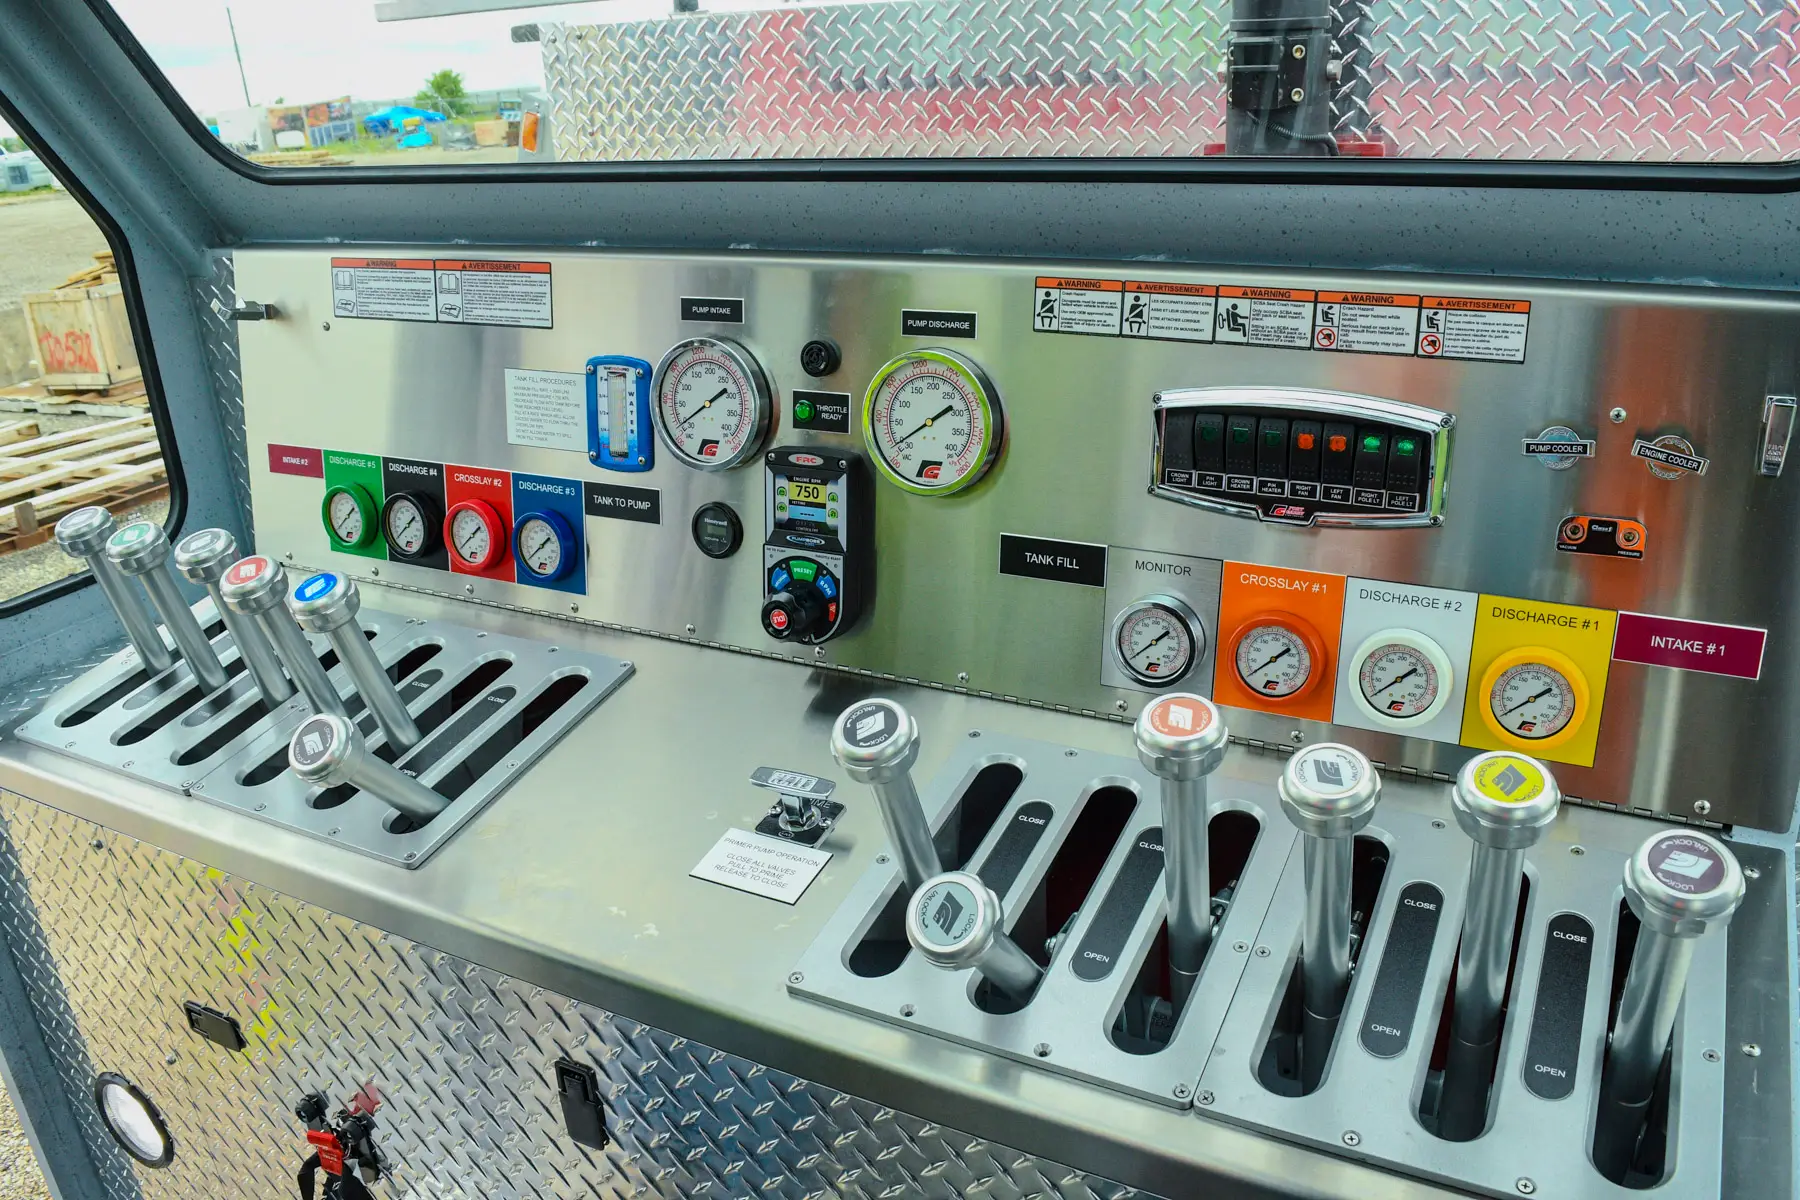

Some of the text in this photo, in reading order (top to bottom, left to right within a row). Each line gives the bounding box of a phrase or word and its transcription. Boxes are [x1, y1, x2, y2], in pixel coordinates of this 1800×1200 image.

[469, 262, 520, 270] AVERTISSEMENT
[1144, 284, 1204, 293] AVERTISSEMENT
[1250, 289, 1290, 298] WARNING
[1351, 295, 1394, 304] WARNING
[1446, 300, 1516, 309] AVERTISSEMENT
[692, 306, 730, 315] PUMP INTAKE
[929, 320, 970, 330] DISCHARGE
[912, 360, 927, 369] 1200
[692, 371, 702, 379] 150
[540, 378, 576, 386] PROCEDURES
[886, 376, 896, 388] 800
[817, 405, 847, 414] THROTTLE
[822, 412, 842, 421] READY
[952, 428, 965, 436] 350
[1530, 445, 1583, 453] PUMP COOLER
[282, 457, 300, 465] INTAKE
[329, 456, 366, 468] DISCHARGE
[796, 456, 816, 464] FRC
[1640, 447, 1698, 469] ENGINE COOLER
[389, 462, 437, 476] DISCHARGE #4
[454, 473, 502, 487] CROSSLAY #2
[519, 481, 575, 496] DISCHARGE #3
[796, 485, 819, 499] 750
[593, 495, 650, 510] TANK TO PUMP
[1025, 552, 1079, 569] TANK FILL
[1135, 560, 1192, 577] MONITOR
[820, 580, 831, 595] RPM
[1240, 573, 1327, 593] CROSSLAY #1
[1359, 588, 1462, 612] DISCHARGE #2
[1492, 606, 1599, 631] DISCHARGE #1
[1650, 634, 1726, 656] INTAKE #1
[851, 706, 875, 719] UNLOCK
[870, 734, 888, 745] LOCK
[1299, 768, 1307, 783] LOCK
[1348, 760, 1358, 781] UNLOCK
[1018, 814, 1045, 826] CLOSE
[1139, 840, 1166, 852] CLOSE
[1674, 839, 1709, 852] UNLOCK
[724, 838, 820, 867] PRIMER PUMP OPERATION
[727, 853, 796, 876] CLOSE ALL VALVES
[728, 861, 745, 870] PULL
[760, 869, 784, 880] PRIME
[714, 864, 788, 889] RELEASE TO CLOSE
[1668, 880, 1694, 891] LOCK
[921, 890, 938, 917] UNLOCK
[1404, 898, 1437, 911] CLOSE
[963, 913, 975, 933] LOCK
[1553, 930, 1588, 943] CLOSE
[1084, 950, 1110, 963] OPEN
[1371, 1023, 1400, 1037] OPEN
[1534, 1064, 1566, 1078] OPEN
